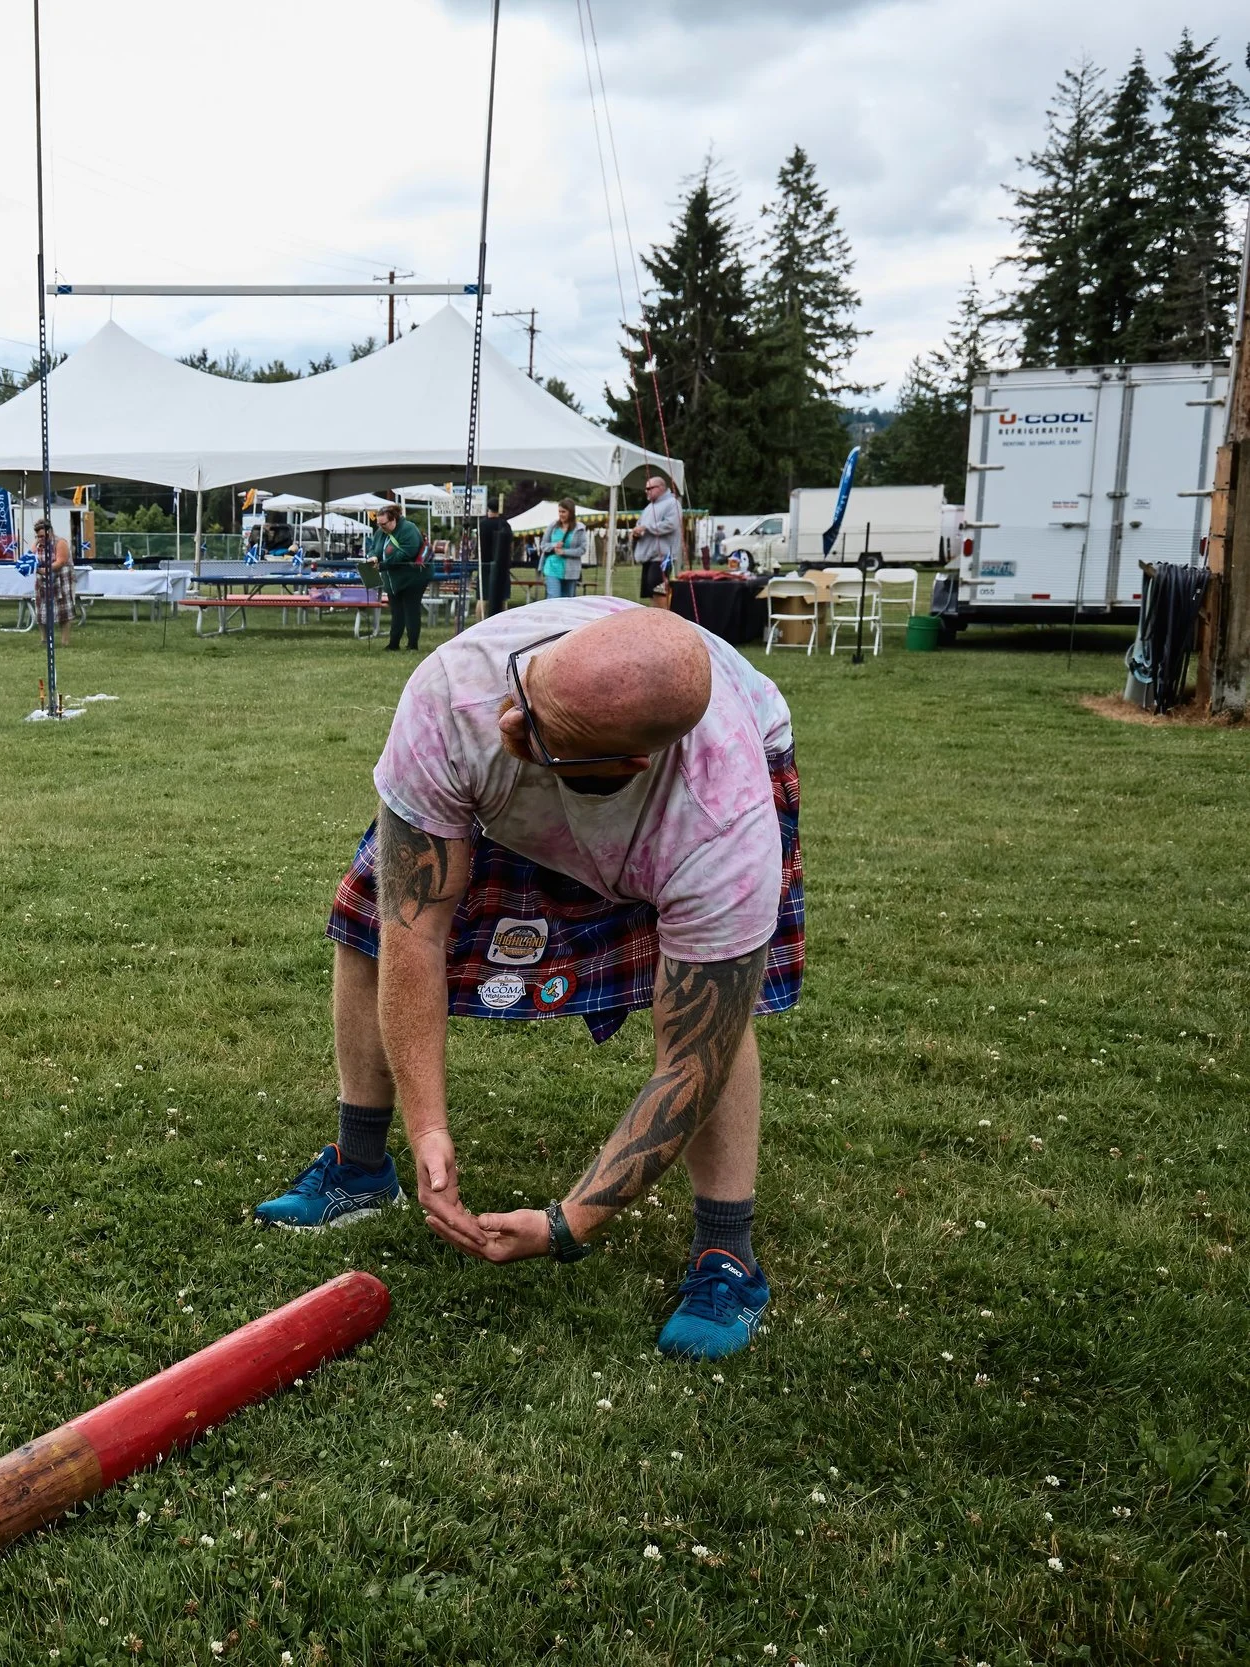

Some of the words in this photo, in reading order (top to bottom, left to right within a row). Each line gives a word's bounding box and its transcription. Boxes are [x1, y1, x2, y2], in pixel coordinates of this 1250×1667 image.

[998, 427, 1079, 436] REFRIGERATION
[493, 932, 547, 948] HIGHLAND
[478, 985, 525, 995] TACOMA
